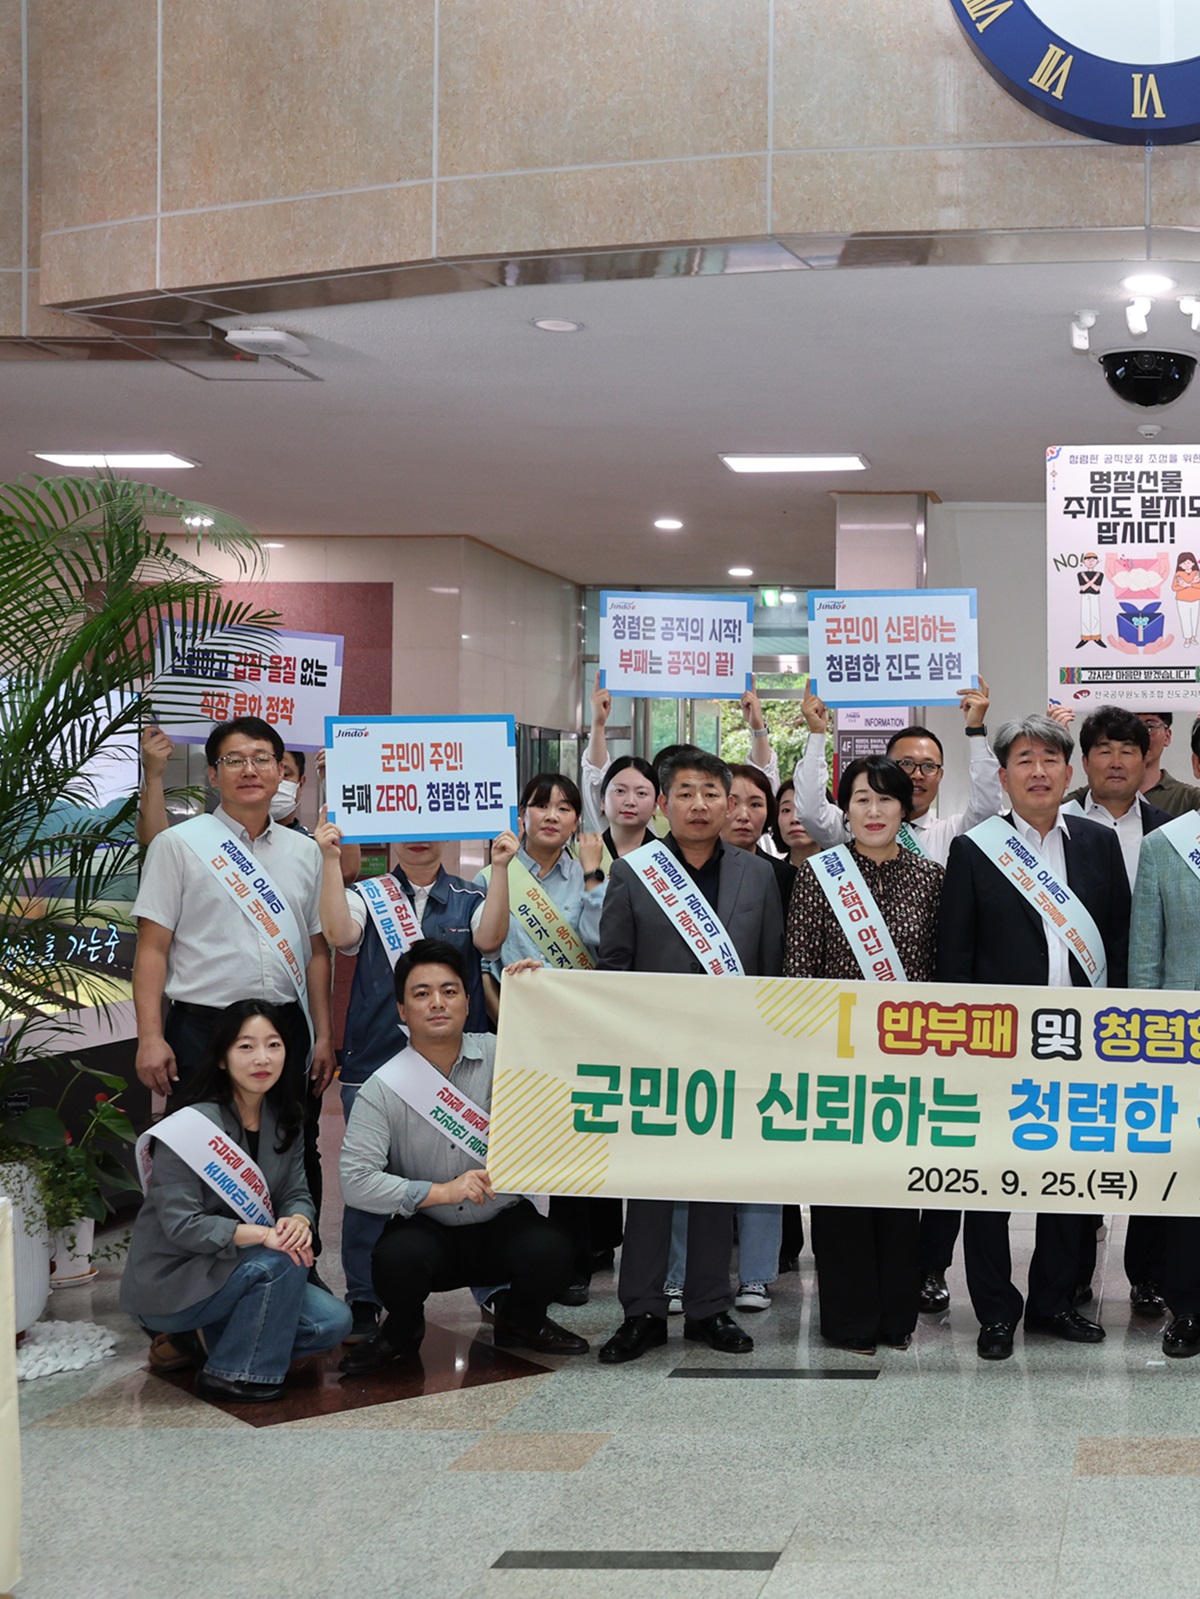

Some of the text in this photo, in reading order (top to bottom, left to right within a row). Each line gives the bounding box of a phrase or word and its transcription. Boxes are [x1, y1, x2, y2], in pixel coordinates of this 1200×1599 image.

[1131, 73, 1166, 118] VI
[1069, 454, 1098, 465] 청렴한
[1104, 454, 1143, 464] 공직문화
[1149, 453, 1178, 464] 조성을
[1090, 470, 1182, 494] 명절선물
[1063, 496, 1133, 519] 주지도
[1097, 521, 1175, 545] 맙시다!
[1053, 553, 1085, 572] NO!
[612, 614, 742, 644] 청렴은 공직의 시작!
[825, 615, 956, 645] 군민이 신뢰하는
[300, 657, 328, 687] 없는
[619, 649, 734, 677] 부패는 공직의 끝!
[826, 652, 962, 683] 청렴한 진도 실현
[1087, 670, 1190, 680] 감사한 마음만 받겠습니다!
[200, 690, 295, 725] 직장 문화 정착
[1094, 689, 1164, 699] 전국공무원노동조합
[864, 717, 904, 727] INFORMATION
[381, 742, 463, 772] 군민이 주인!
[842, 741, 852, 753] 4F
[341, 781, 503, 814] 부패 ZERO, 청렴한 진도
[220, 839, 285, 915] 청렴한 오늘이
[1005, 836, 1071, 905] 청렴한 오늘이
[210, 855, 229, 871] 더
[225, 871, 251, 899] 나은
[247, 899, 281, 938] 내일을
[651, 850, 721, 938] 청렴은 공직의
[998, 851, 1014, 867] 더
[1011, 865, 1036, 893] 나은
[1033, 894, 1068, 928] 내일을
[394, 904, 417, 937] 없는
[517, 903, 550, 942] 우리가
[526, 886, 580, 951] 당신의 용기
[642, 865, 712, 954] 부패는 공직의
[837, 881, 869, 923] 선택이
[857, 925, 884, 956] 아닌
[67, 924, 120, 964] 가는중
[380, 917, 403, 951] 문화
[879, 1002, 1017, 1057] 반부패
[1031, 1008, 1082, 1061] 및
[429, 1105, 469, 1141] 건강한
[435, 1087, 489, 1133] 갑질 을질
[571, 1063, 735, 1140] 군민이
[756, 1072, 981, 1148] 신뢰하는
[1007, 1078, 1179, 1154] 청렴한
[207, 1134, 266, 1195] 갑질 을질
[203, 1161, 258, 1218] 존중하는
[907, 1166, 988, 1196] 2025.
[1000, 1170, 1028, 1197] 9.
[1041, 1170, 1139, 1201] 25.(목)
